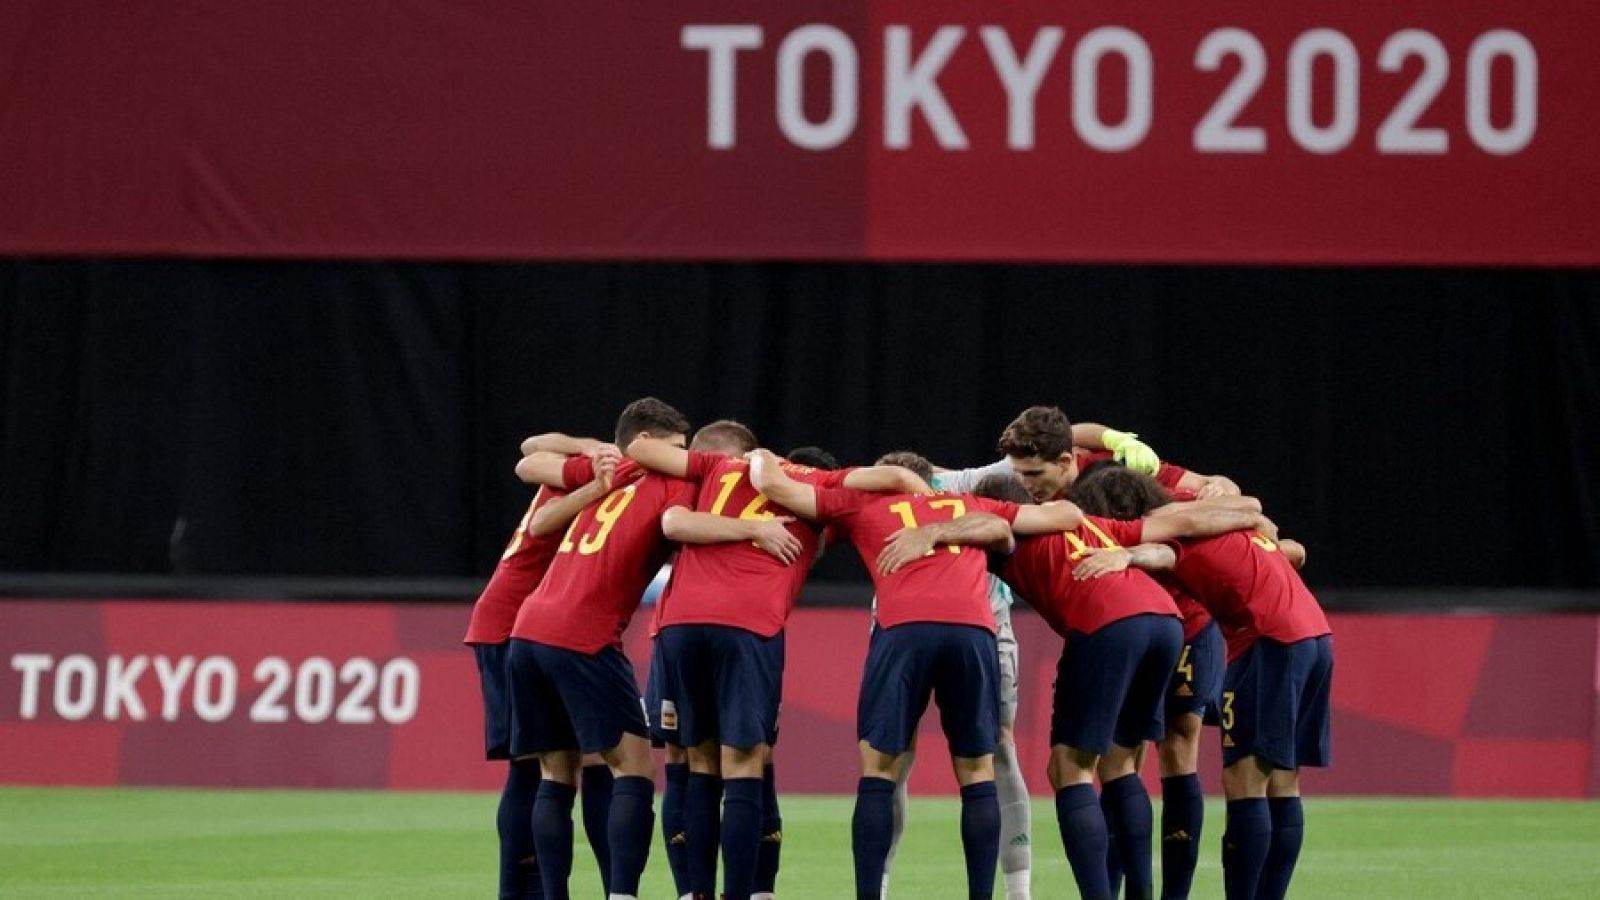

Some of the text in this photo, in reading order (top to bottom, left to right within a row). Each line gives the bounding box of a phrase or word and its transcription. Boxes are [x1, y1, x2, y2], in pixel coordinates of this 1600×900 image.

[681, 24, 1539, 154] TOKYO 2020
[11, 654, 420, 723] TOKYO 2020
[1177, 645, 1192, 682] 4
[1222, 692, 1235, 730] 3
